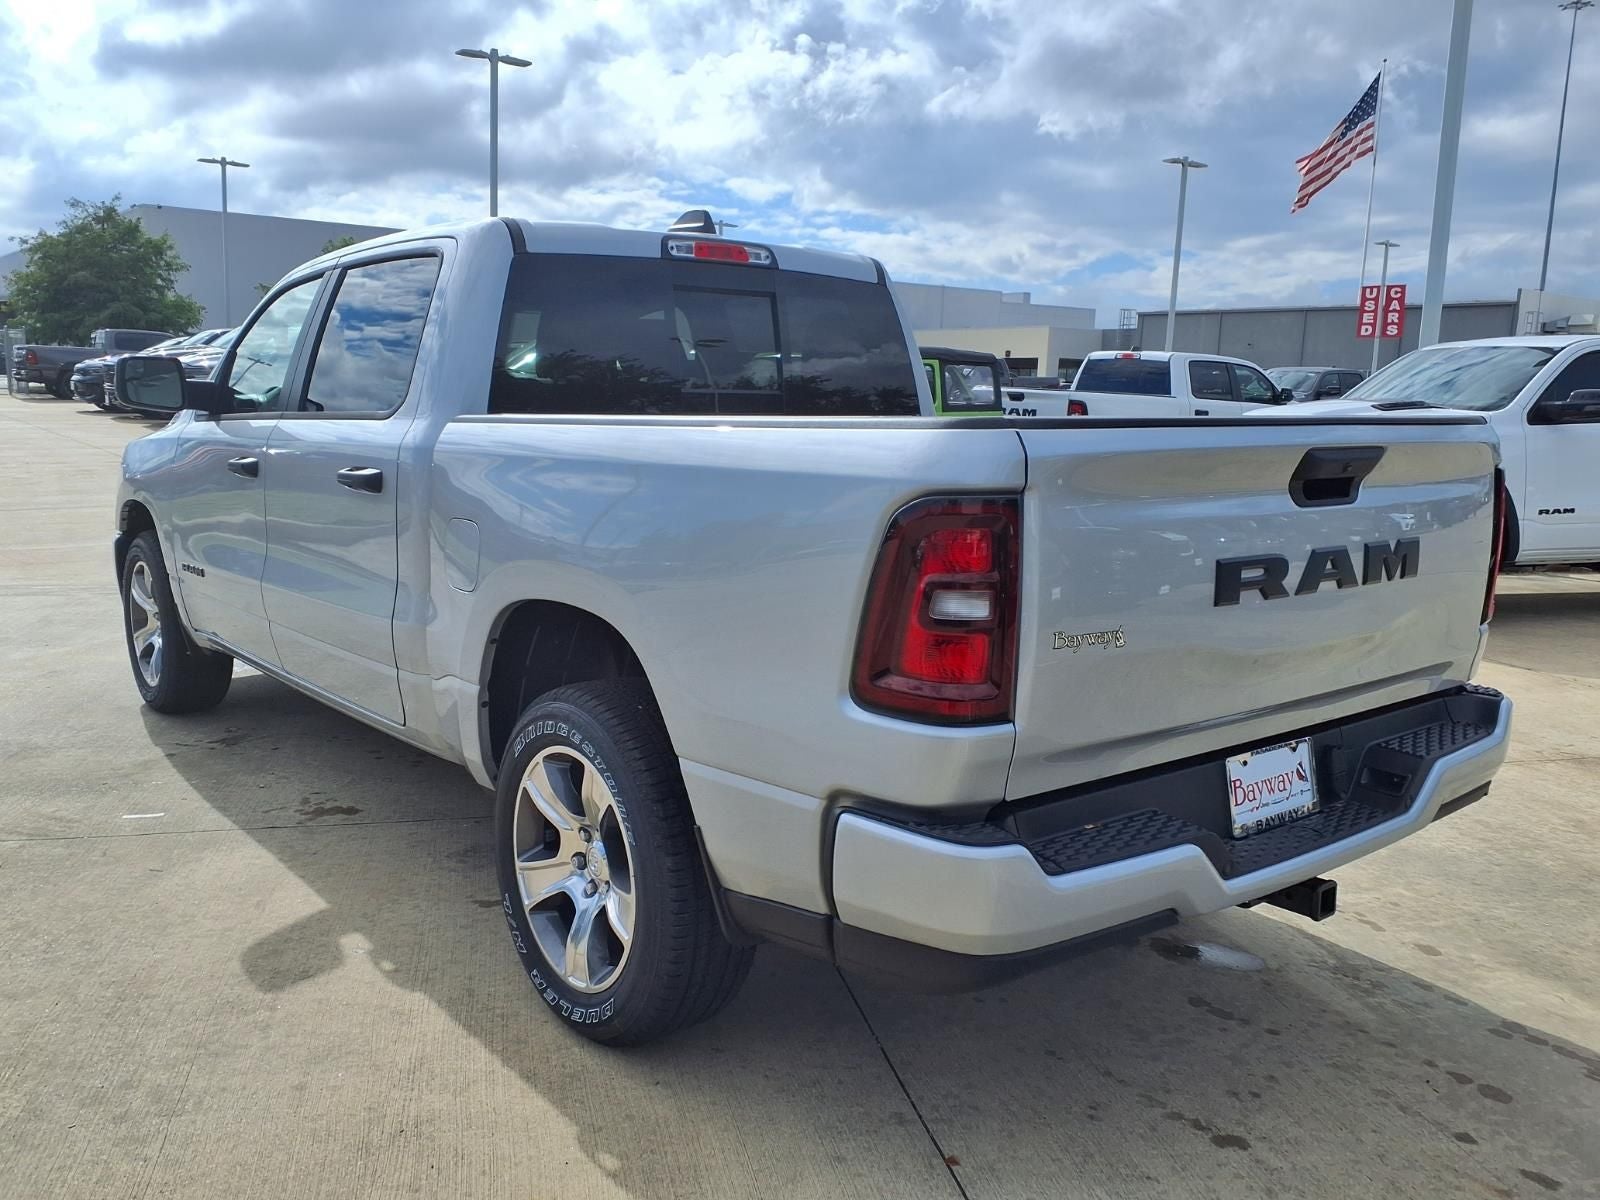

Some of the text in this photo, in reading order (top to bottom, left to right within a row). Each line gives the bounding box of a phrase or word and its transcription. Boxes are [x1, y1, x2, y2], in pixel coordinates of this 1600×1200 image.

[1360, 287, 1378, 336] USED
[1386, 287, 1402, 336] CARS
[1001, 407, 1037, 417] AM
[1538, 507, 1576, 516] RAM
[1213, 536, 1421, 608] RAM
[513, 720, 636, 846] BRIDGESTONE
[1231, 770, 1295, 811] Bayway
[1256, 807, 1300, 832] BAYWAY
[530, 968, 614, 1023] DUELER
